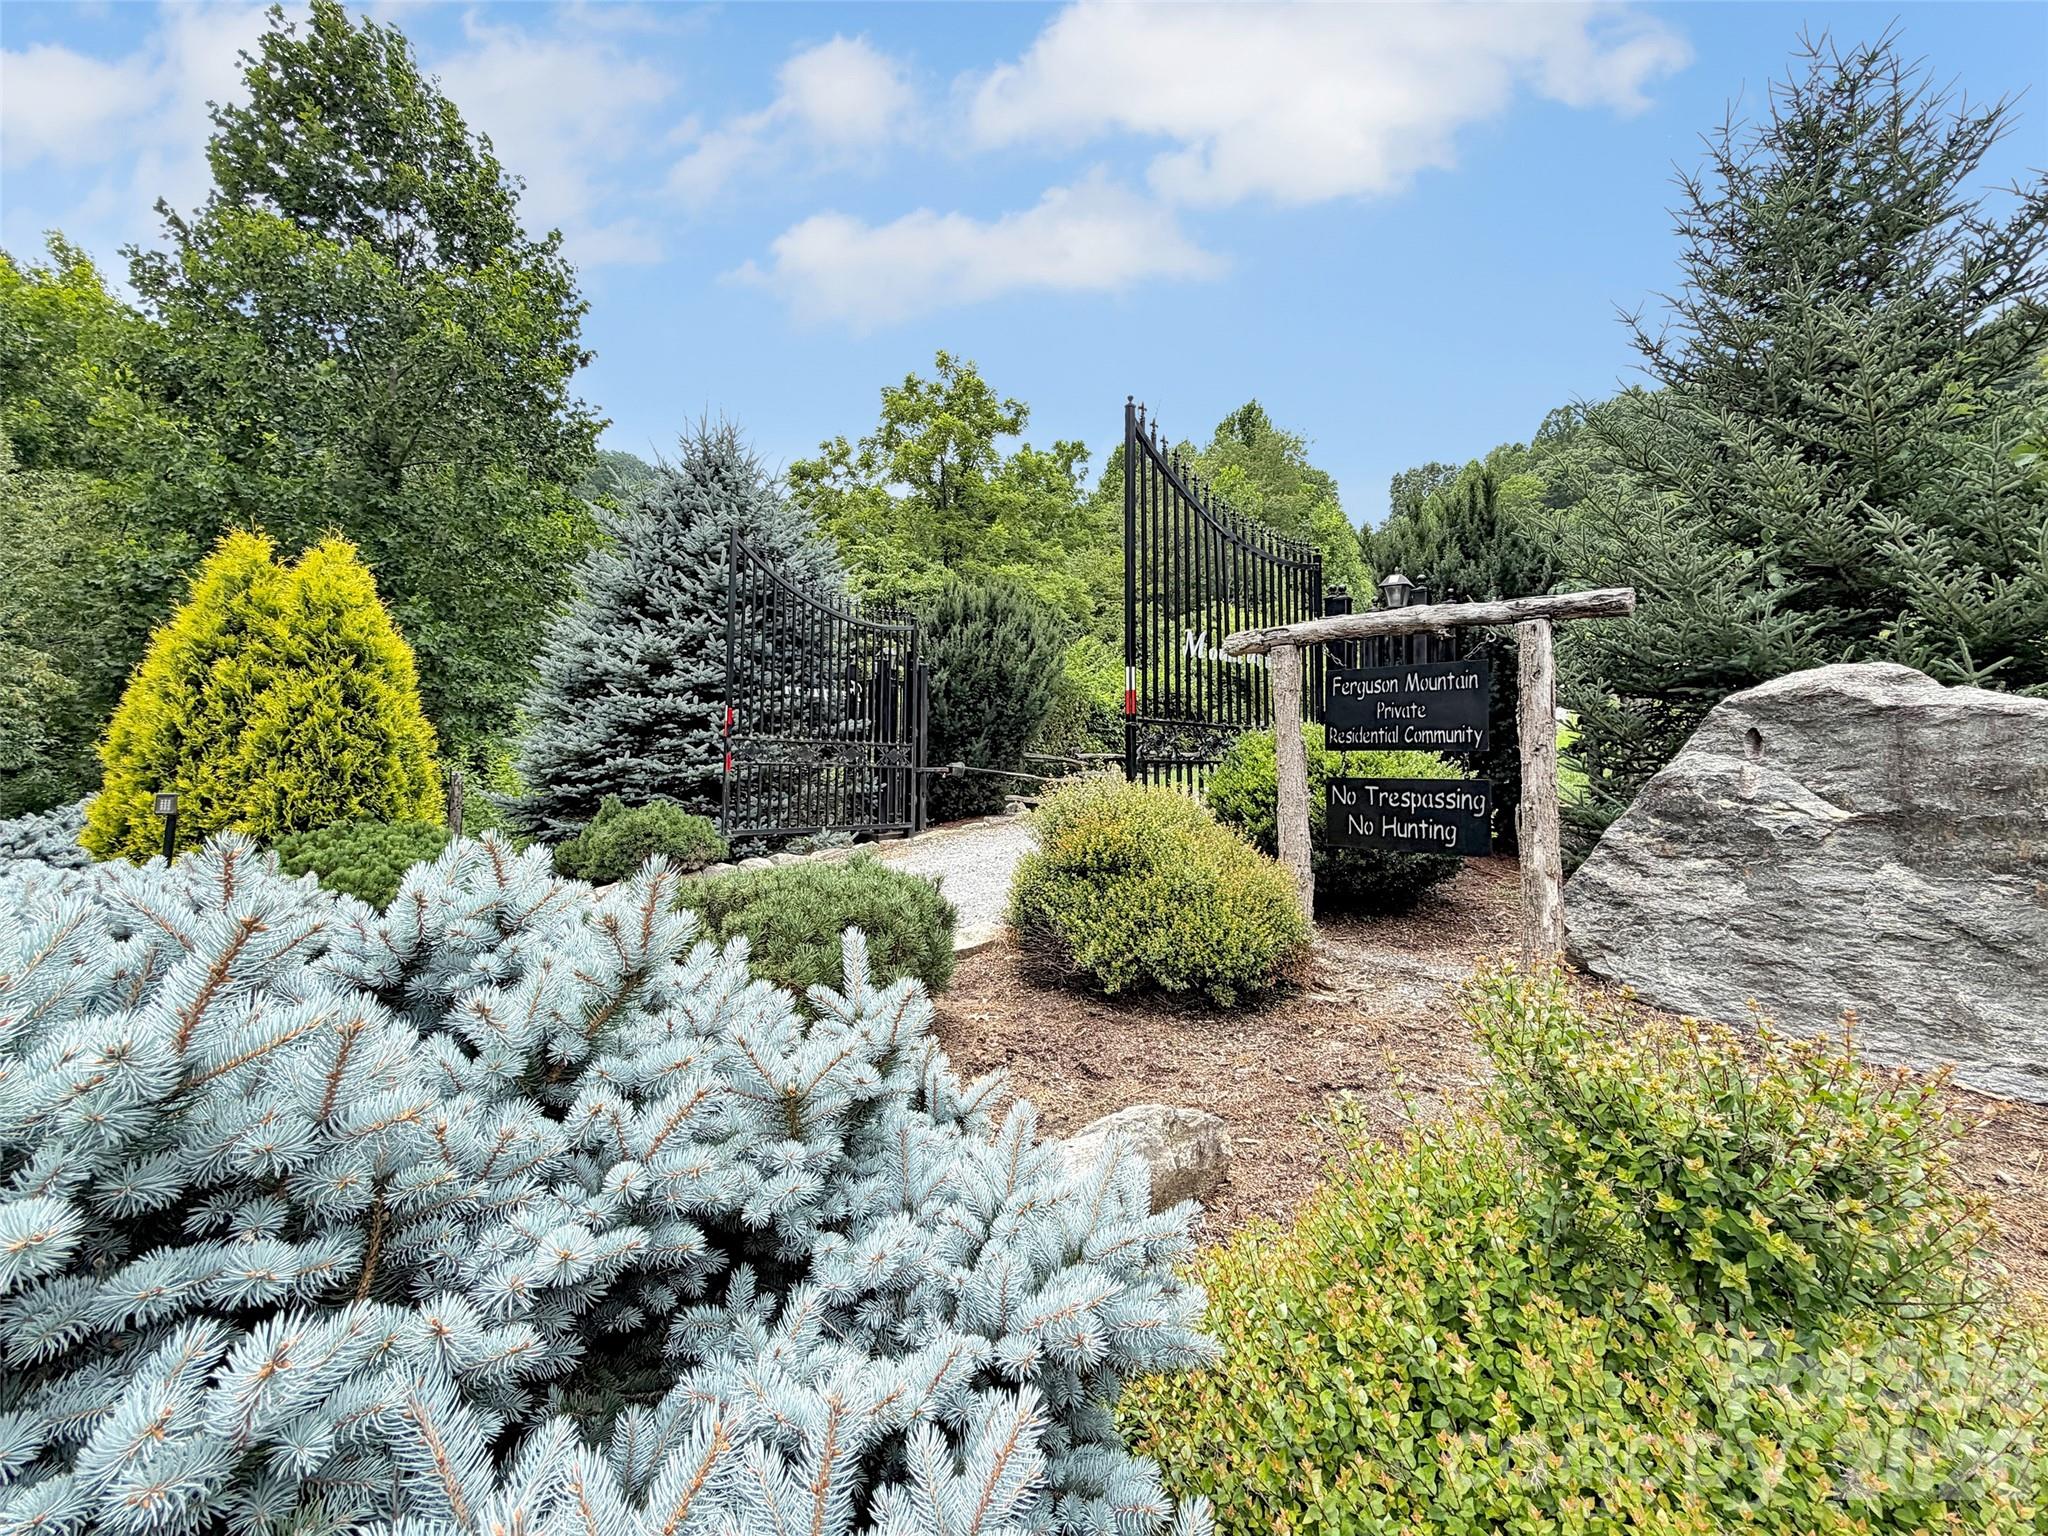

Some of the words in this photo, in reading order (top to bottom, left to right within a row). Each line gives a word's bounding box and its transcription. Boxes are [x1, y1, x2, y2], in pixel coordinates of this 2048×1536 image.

[1332, 676, 1398, 700] Ferguson
[1405, 670, 1479, 692] Mountain
[1376, 701, 1427, 719] Private
[1329, 725, 1399, 744] Residential
[1404, 725, 1483, 748] Community
[1331, 785, 1356, 805] No
[1364, 786, 1485, 817] Trespassing
[1348, 814, 1374, 836] No
[1382, 815, 1457, 847] Hunting
